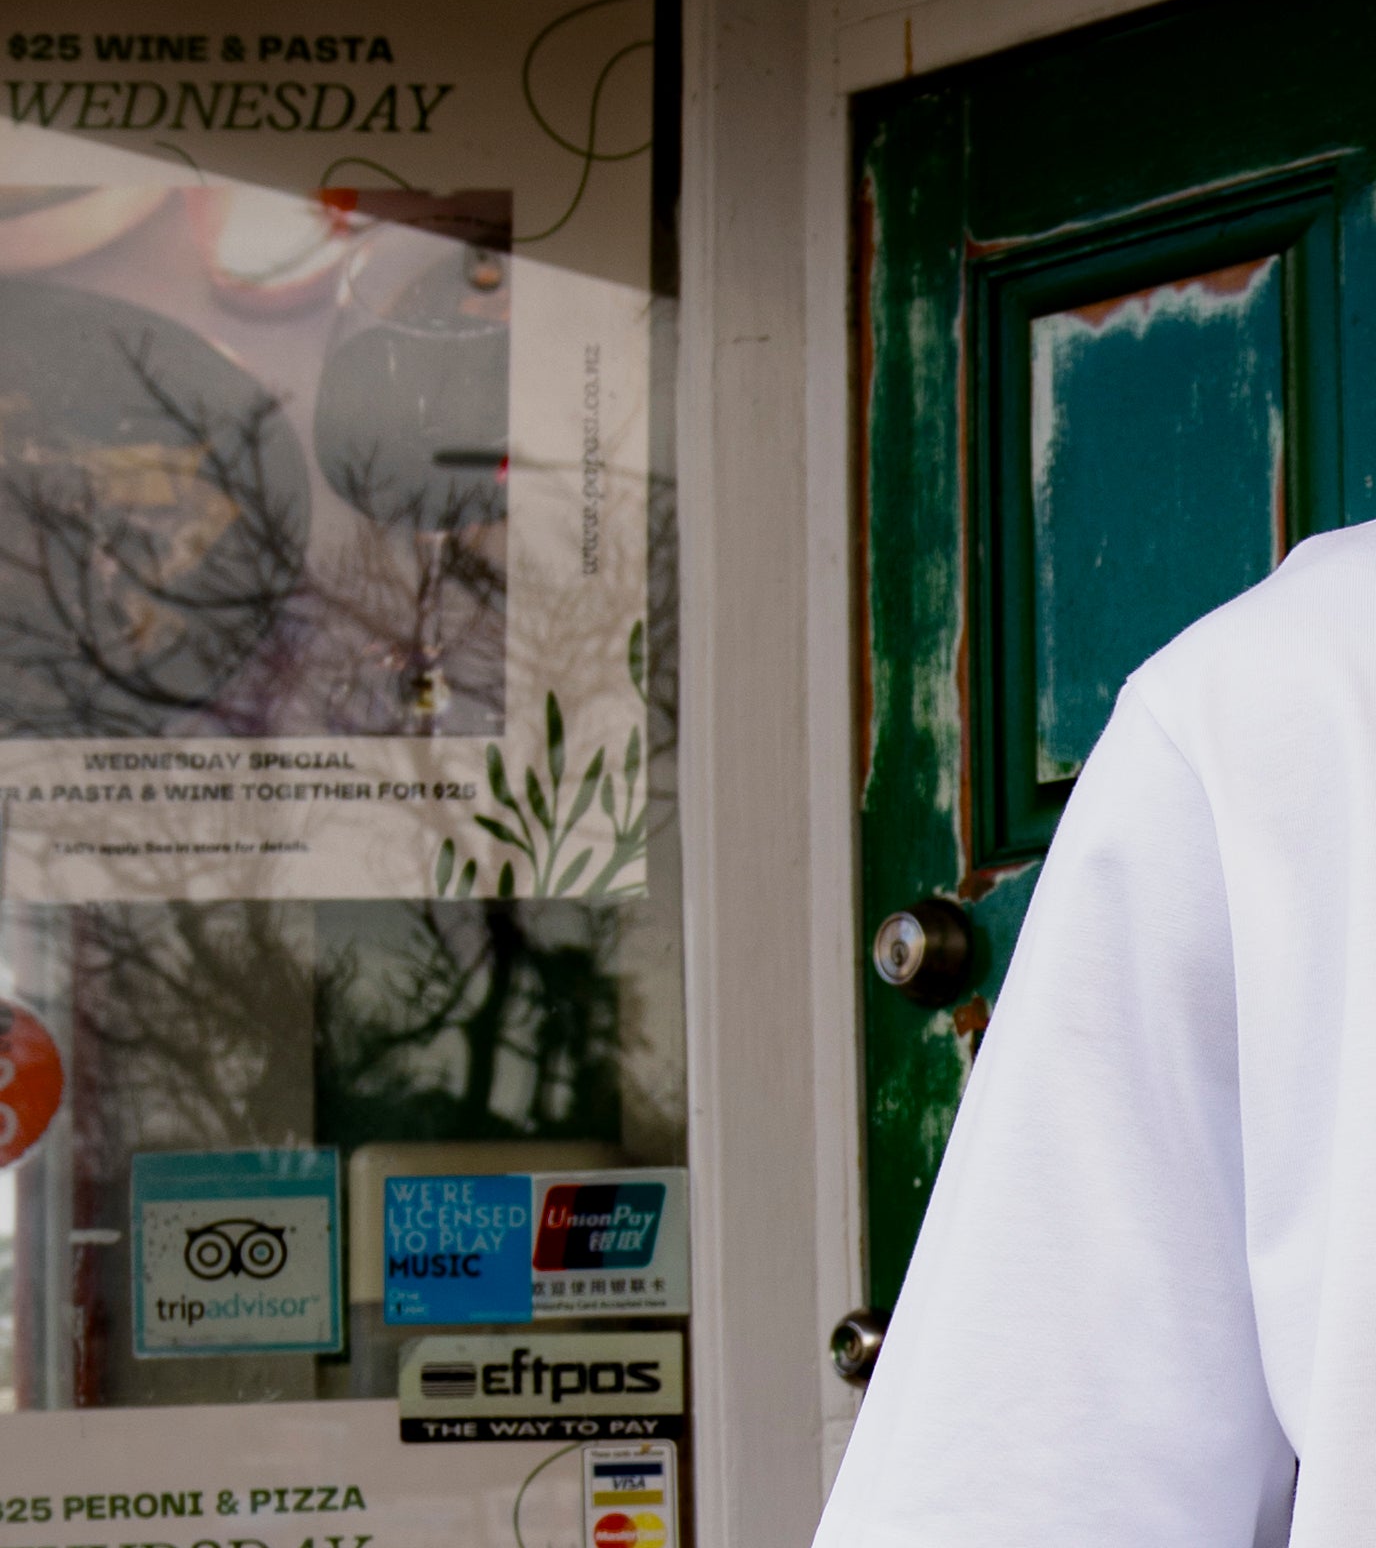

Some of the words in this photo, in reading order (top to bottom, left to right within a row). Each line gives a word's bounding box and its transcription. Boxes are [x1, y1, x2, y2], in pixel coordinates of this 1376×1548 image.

[8, 34, 81, 62] $25
[94, 34, 209, 63] WINE
[220, 35, 246, 63] &
[257, 35, 394, 64] PASTA
[3, 80, 456, 133] WEDNESDAY
[84, 752, 242, 771] WEDNESDAY
[249, 752, 356, 770] SPECIAL
[29, 786, 44, 802] A
[52, 784, 133, 802] PASTA
[140, 784, 156, 802] &
[164, 783, 234, 801] WINE
[244, 783, 371, 800] TOGETHER
[379, 782, 426, 800] FOR
[433, 782, 477, 800] $25
[388, 1206, 527, 1230] LICENSED
[546, 1204, 656, 1236] UnionPay
[391, 1231, 427, 1252] TO
[439, 1230, 505, 1252] PLAY
[388, 1254, 481, 1277] MUSIC
[157, 1293, 311, 1328] tripadvisor
[482, 1348, 661, 1402] eftpos
[422, 1421, 478, 1438] THE
[489, 1421, 553, 1438] WAY
[559, 1420, 601, 1437] TO
[608, 1418, 660, 1436] PAY
[611, 1474, 646, 1490] VISA
[0, 1497, 52, 1522] 25
[63, 1491, 204, 1521] PERONI
[216, 1489, 239, 1516] &
[250, 1485, 367, 1514] PIZZA
